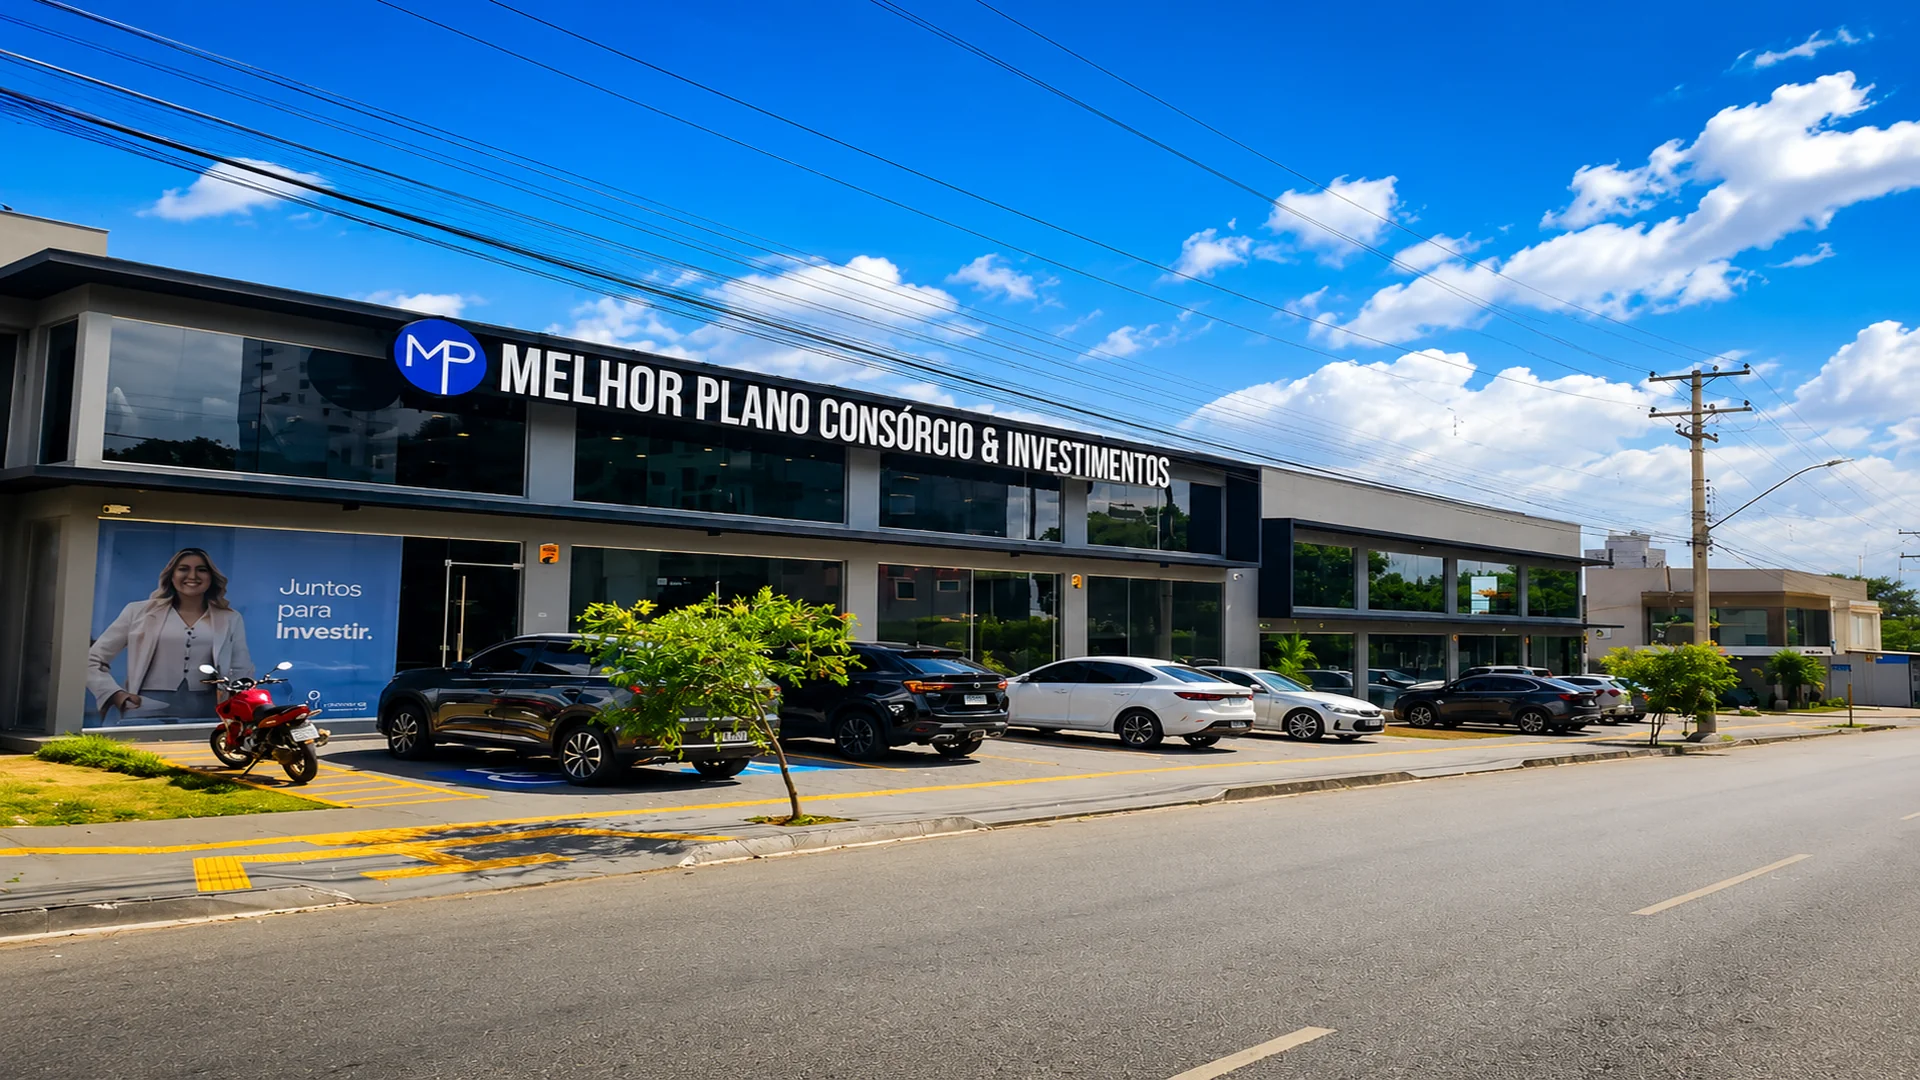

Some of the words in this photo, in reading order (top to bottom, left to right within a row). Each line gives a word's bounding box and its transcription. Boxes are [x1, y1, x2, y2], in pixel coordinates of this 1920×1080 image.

[403, 333, 476, 396] MP
[500, 343, 683, 417] MELHOR
[695, 375, 810, 435] PLANO
[819, 397, 974, 460] CONSÓRCIO
[981, 426, 1000, 464] &
[1006, 430, 1171, 489] INVESTIMENTOS
[279, 578, 362, 597] Juntos
[278, 604, 331, 622] para
[276, 622, 373, 640] Investir.
